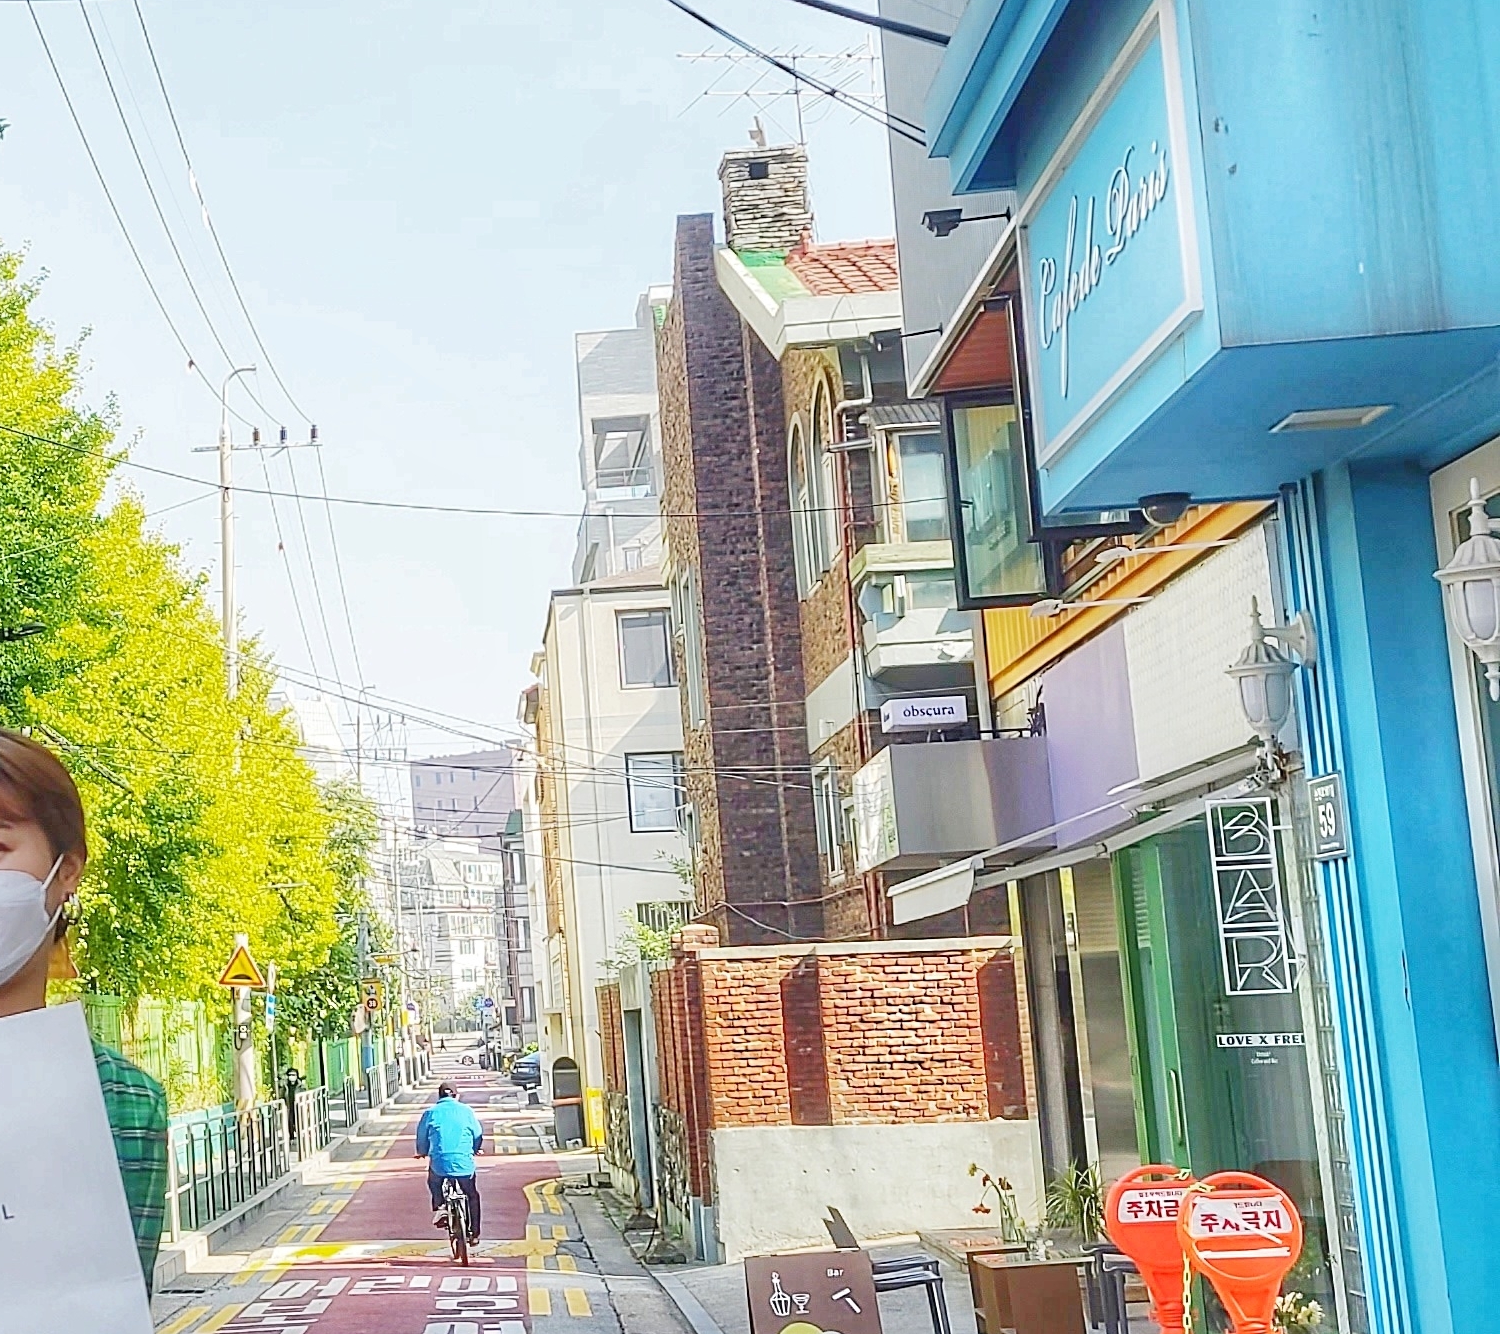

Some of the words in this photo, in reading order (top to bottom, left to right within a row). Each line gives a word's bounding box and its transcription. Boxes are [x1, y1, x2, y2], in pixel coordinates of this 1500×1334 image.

[1104, 140, 1170, 265] Paris
[1317, 801, 1336, 838] 59
[1218, 1035, 1253, 1046] LOVE
[1259, 1035, 1269, 1045] X
[1126, 1199, 1180, 1219] 주차금
[826, 1268, 844, 1277] Bar
